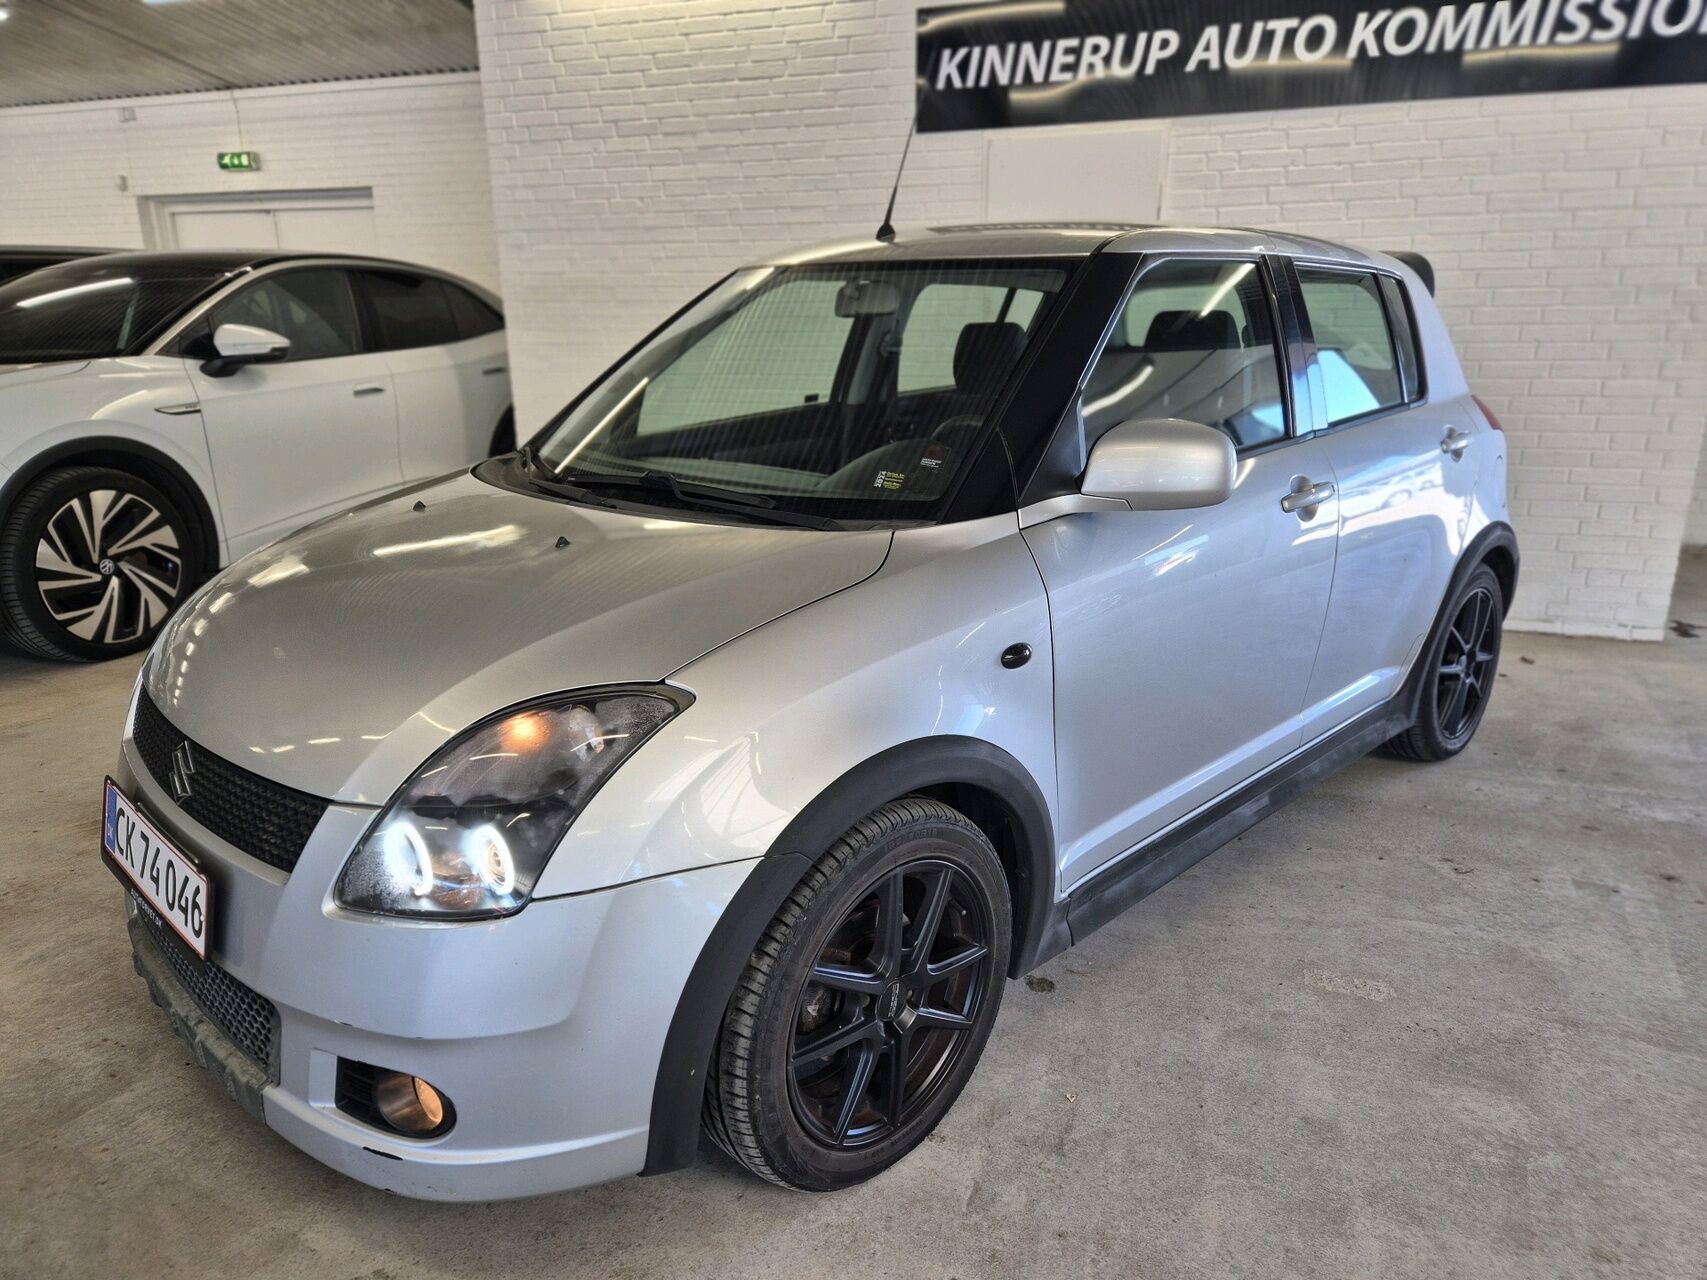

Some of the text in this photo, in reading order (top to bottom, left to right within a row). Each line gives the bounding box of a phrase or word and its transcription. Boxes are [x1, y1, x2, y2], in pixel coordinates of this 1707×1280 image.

[934, 0, 1707, 91] KINNERUP AUTO KOMMISSIO
[115, 807, 136, 869] CK
[140, 830, 160, 897] 74
[165, 859, 203, 939] 046
